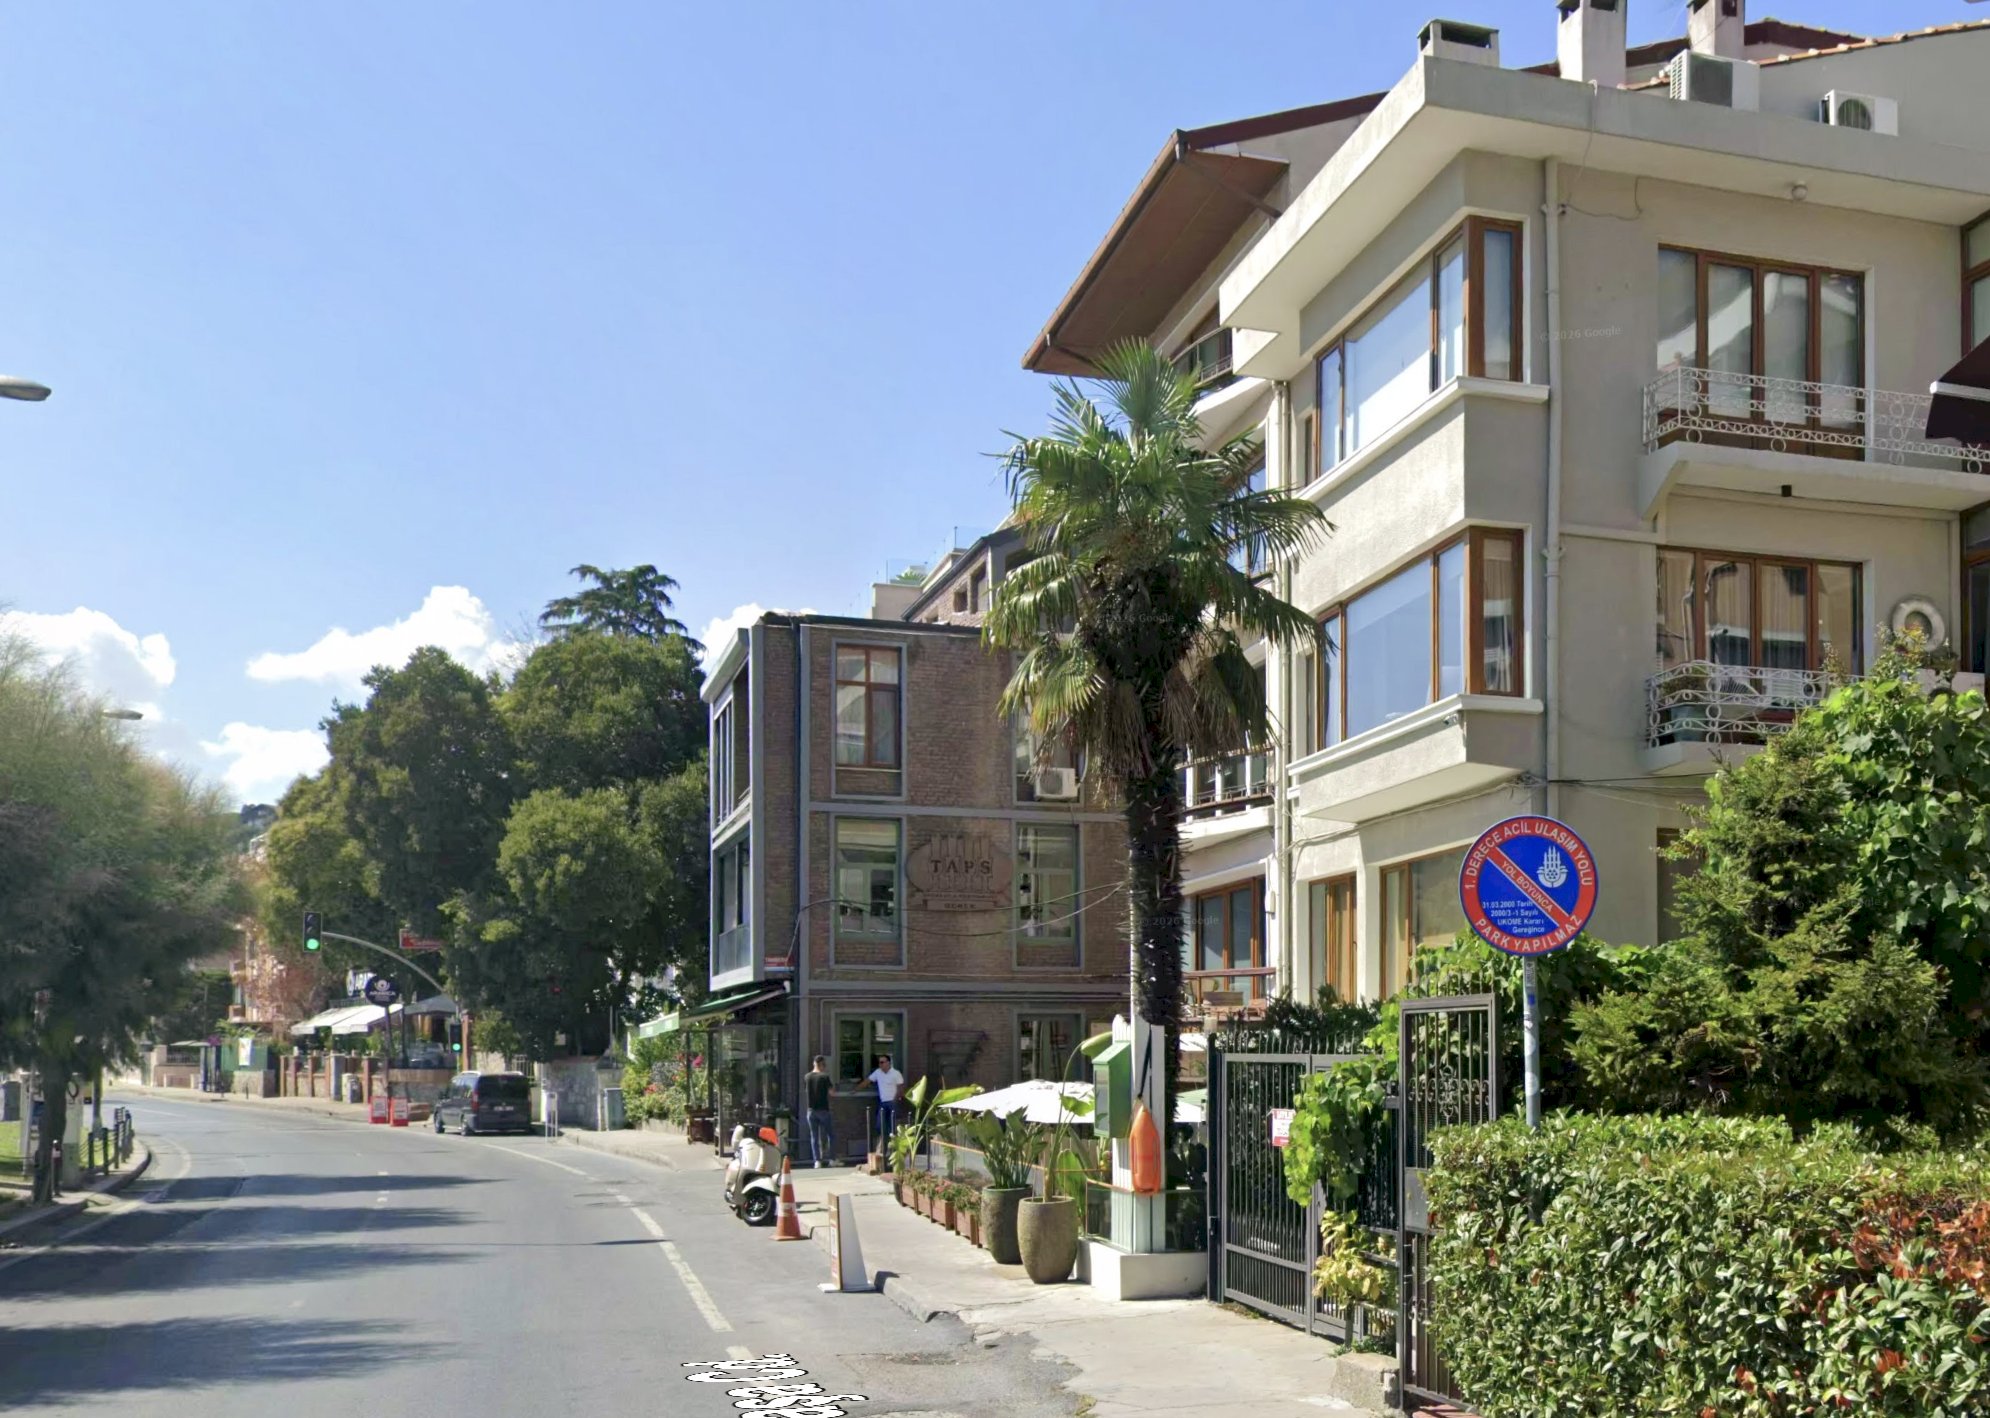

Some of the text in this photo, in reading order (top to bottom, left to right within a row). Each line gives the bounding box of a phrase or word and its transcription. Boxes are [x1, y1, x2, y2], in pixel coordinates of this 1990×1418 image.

[930, 859, 992, 874] TAPS
[1466, 832, 1502, 877] DERECE
[1504, 820, 1531, 839] ACİL
[1535, 822, 1578, 853] ULAŞIM
[1574, 852, 1593, 886] YOLU
[1501, 860, 1554, 912] YOL BOYUNCA
[1476, 915, 1582, 952] PARK YAPILMAZ
